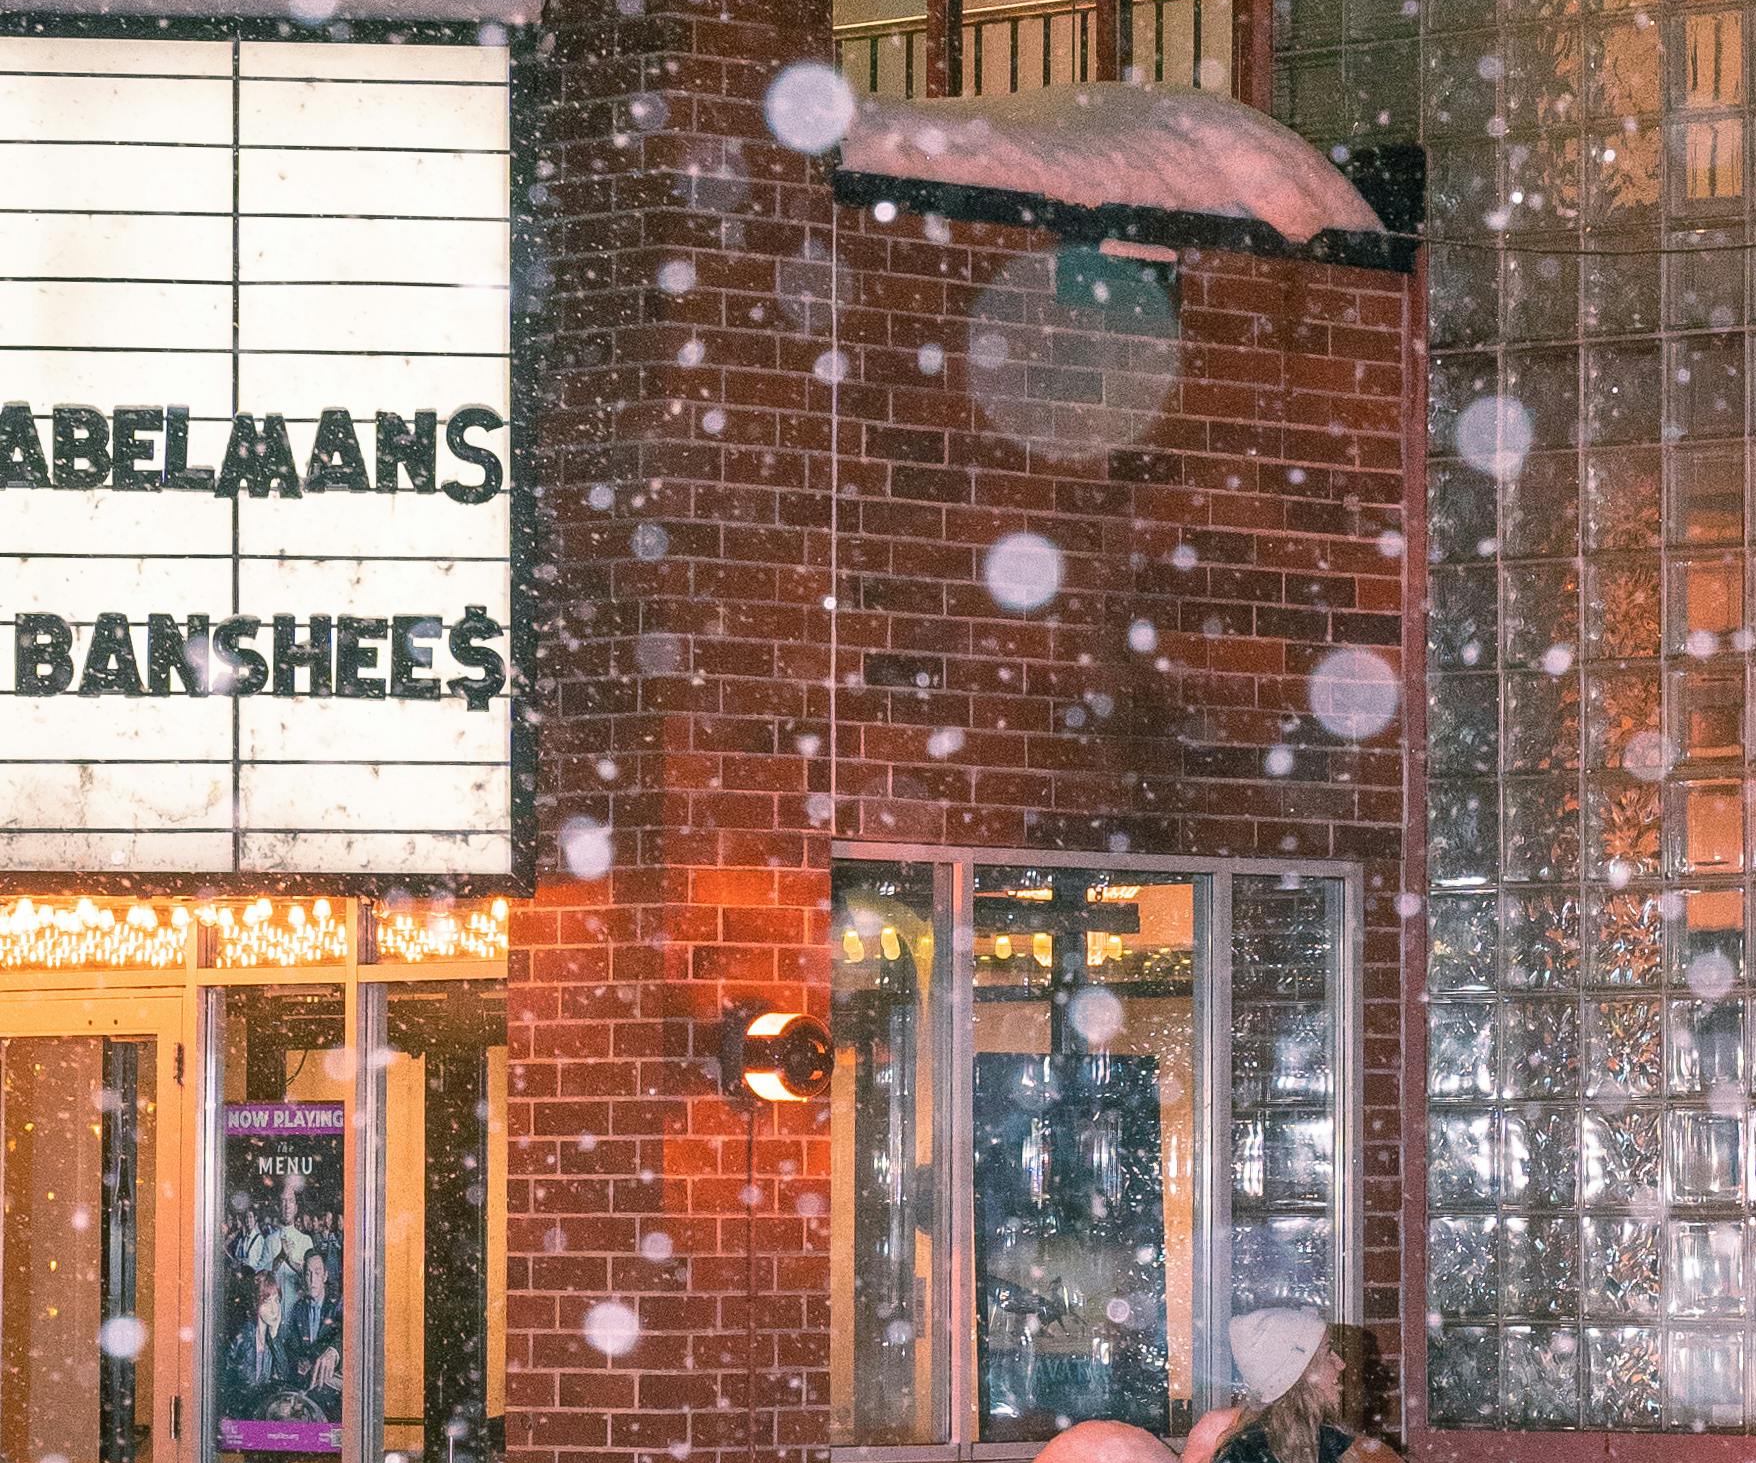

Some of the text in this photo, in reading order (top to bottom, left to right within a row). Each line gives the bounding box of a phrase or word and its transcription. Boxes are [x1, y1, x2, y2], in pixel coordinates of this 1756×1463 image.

[0, 402, 504, 504] ABELMANS
[228, 1110, 344, 1128] NOW PLAYING
[259, 1156, 313, 1175] MENU
